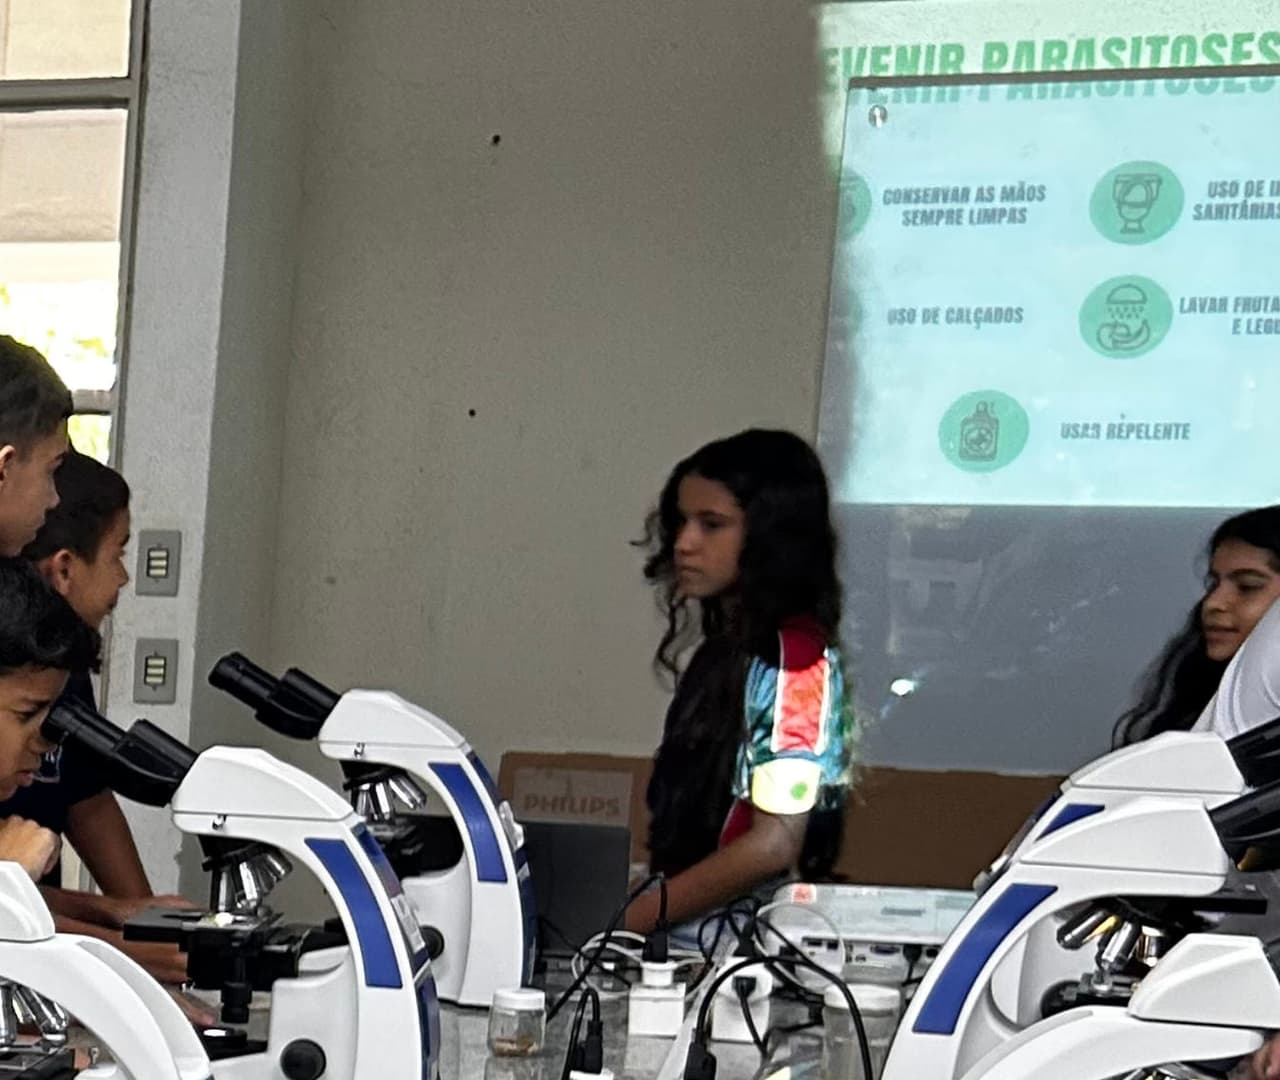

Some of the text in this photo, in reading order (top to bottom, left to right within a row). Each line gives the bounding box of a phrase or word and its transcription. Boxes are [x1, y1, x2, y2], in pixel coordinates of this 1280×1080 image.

[979, 32, 1280, 101] PARASITOSES
[883, 181, 1047, 205] CONSERVAR AS MÃOS
[1208, 181, 1240, 198] USO
[1244, 180, 1265, 198] DE
[902, 207, 1028, 226] SEMPRE LIMPAS
[1180, 296, 1228, 314] LAVAR
[888, 306, 1024, 330] USO DE CALÇADOS
[1232, 318, 1241, 335] E
[524, 794, 620, 816] PHILIPS
